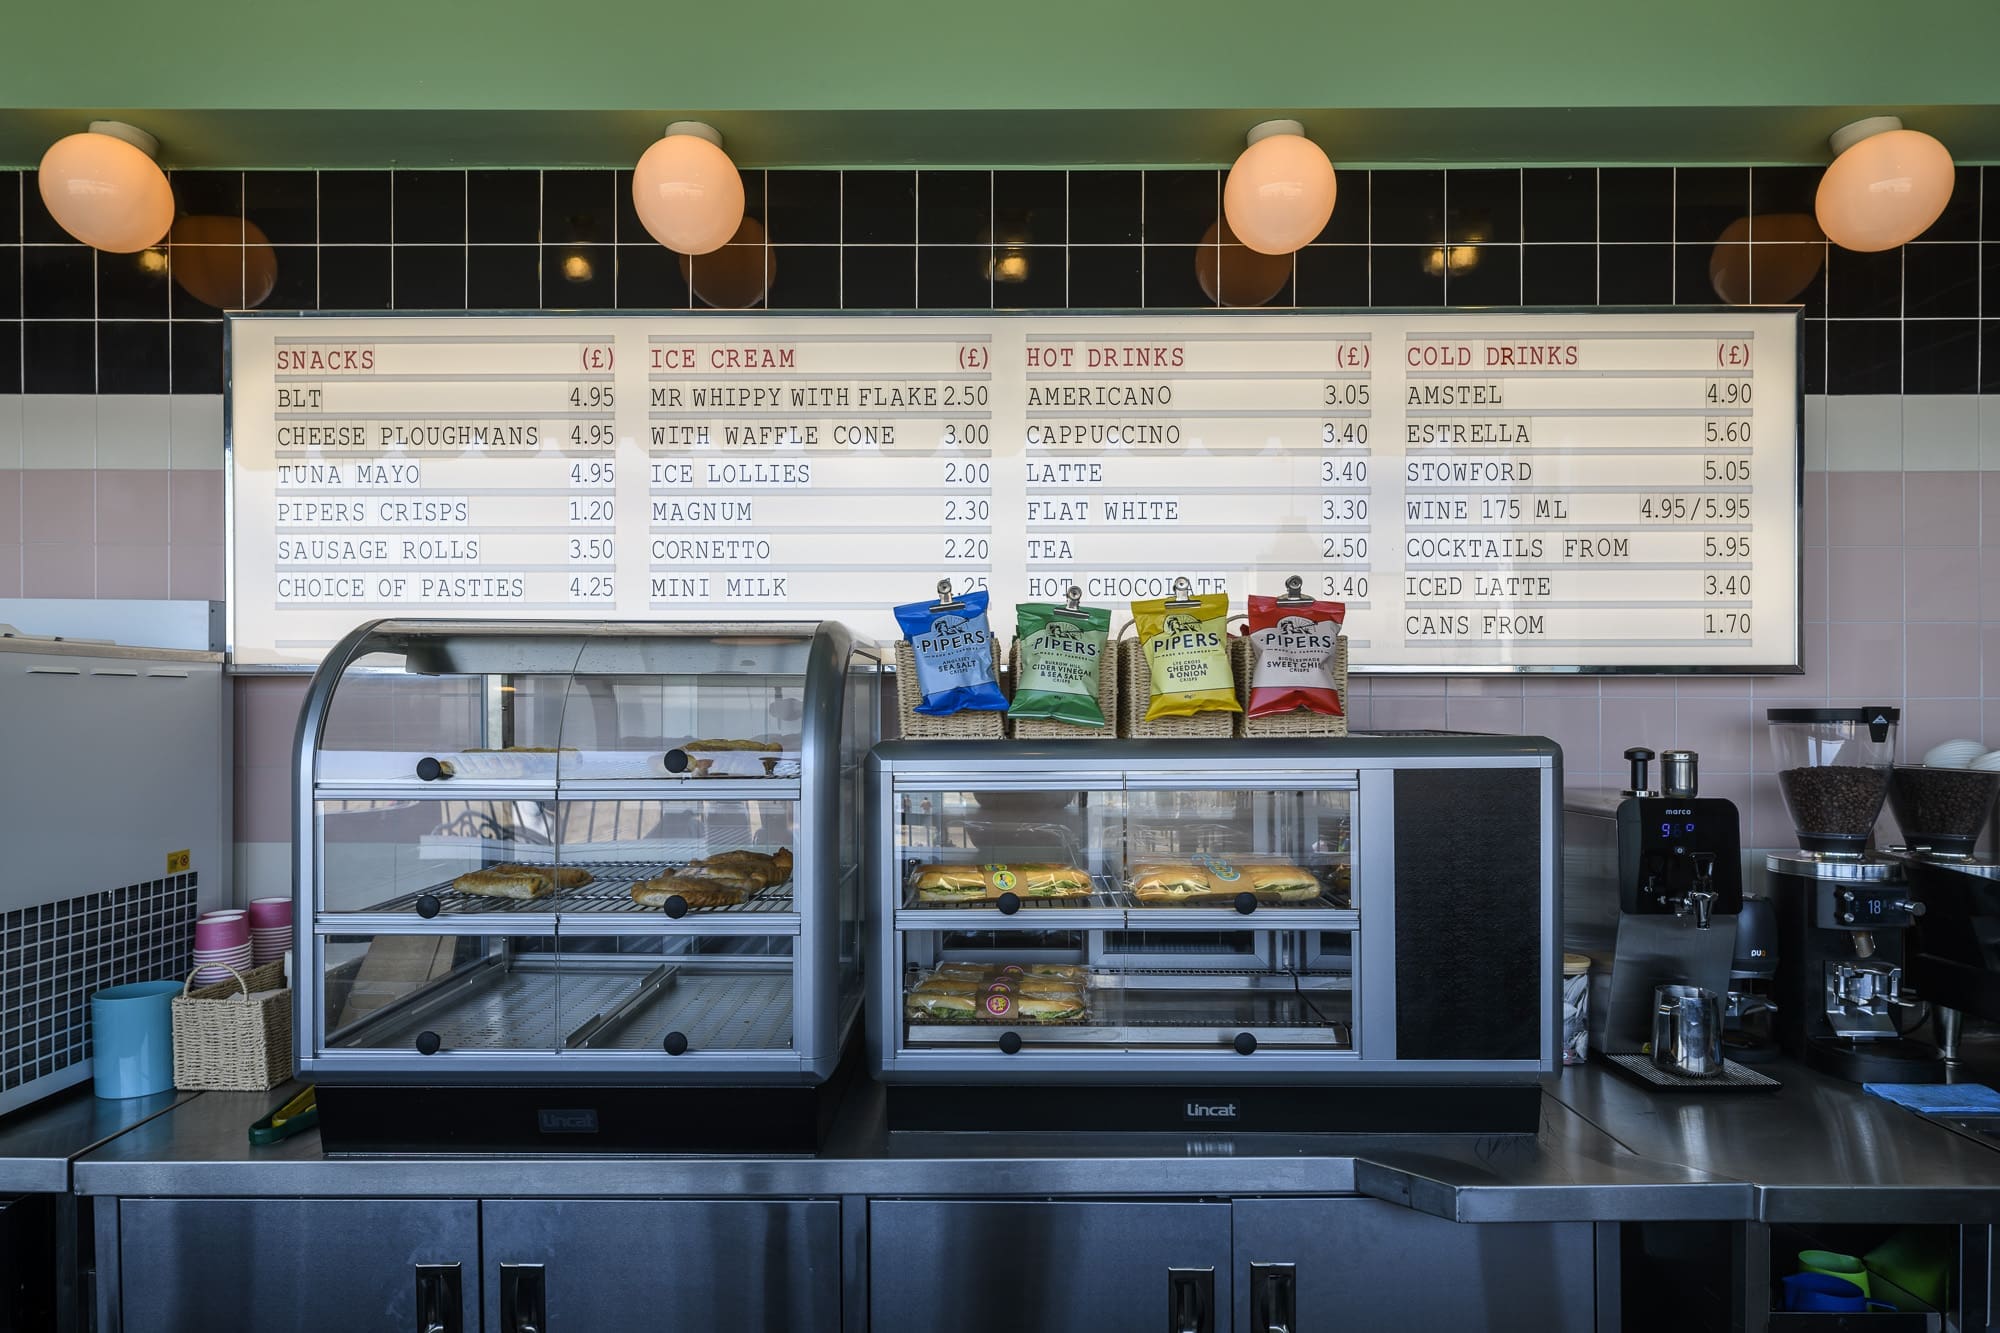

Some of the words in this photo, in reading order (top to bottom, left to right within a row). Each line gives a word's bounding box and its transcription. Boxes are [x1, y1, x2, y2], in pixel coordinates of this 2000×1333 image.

[278, 351, 373, 369] SNACKS
[583, 348, 613, 370] (£)
[652, 350, 694, 368] ICE
[712, 349, 794, 368] CREAM
[960, 347, 988, 369] (£)
[1027, 348, 1073, 367] HOT
[1088, 348, 1183, 367] DRINKS
[1338, 345, 1369, 368] (£)
[1408, 347, 1470, 366] COLD
[1487, 346, 1577, 365] DRINKS
[1719, 344, 1749, 366] (£)
[278, 390, 320, 407] BLT
[571, 387, 613, 406] 4.95
[652, 389, 682, 406] MR
[693, 388, 780, 406] WHIPPY
[791, 388, 848, 406] WITH
[859, 388, 936, 406] FLAKE
[944, 386, 987, 405] 2.50
[1029, 386, 1171, 405] AMERICANO
[1326, 385, 1369, 404] 3.05
[1408, 386, 1501, 404] AMSTEL
[1708, 384, 1751, 403] 4.90
[278, 427, 364, 445] CHEESE
[381, 426, 537, 445] PLOUGHMANS
[571, 425, 613, 444] 4.95
[652, 426, 708, 444] WITH
[725, 426, 817, 444] WAFFLE
[834, 426, 894, 444] CONE
[946, 424, 988, 444] 3.00
[1027, 425, 1179, 444] CAPPUCCINO
[1325, 423, 1367, 444] 3.40
[1408, 424, 1529, 443] ESTRELLA
[1705, 422, 1750, 441] 5.60
[279, 464, 341, 483] TUNA
[358, 465, 418, 483] MAYO
[572, 463, 613, 482] 4.95
[652, 465, 692, 483] ICE
[708, 465, 809, 483] LOLLIES
[946, 463, 989, 483] 2.00
[1027, 464, 1101, 482] LATTE
[1323, 462, 1366, 481] 3.40
[1408, 463, 1531, 481] STOWFORD
[1704, 461, 1749, 480] 5.05
[279, 503, 363, 521] PIPERS
[381, 503, 469, 521] CRISPS
[571, 501, 613, 520] 1.20
[653, 503, 751, 520] MAGNUM
[946, 501, 988, 520] 2.30
[1028, 502, 1088, 520] FLAT
[1105, 502, 1177, 520] WHITE
[1324, 500, 1367, 519] 3.30
[1407, 501, 1467, 519] WINE
[1483, 500, 1520, 519] 175
[1537, 500, 1566, 518] ML
[1642, 498, 1749, 520] 4.95/5.95
[279, 541, 387, 559] SAUSAGE
[403, 541, 477, 559] ROLLS
[571, 539, 612, 558] 3.50
[653, 541, 769, 559] CORNETTO
[945, 539, 988, 559] 2.20
[1028, 541, 1072, 558] TEA
[1324, 538, 1366, 558] 2.50
[1407, 538, 1542, 557] COCKTAILS
[1565, 538, 1628, 557] FROM
[1706, 537, 1749, 556] 5.95
[279, 579, 363, 597] CHOICE
[379, 579, 405, 597] OF
[423, 579, 522, 597] PASTIES
[571, 577, 613, 596] 4.25
[652, 579, 708, 596] MINI
[727, 579, 786, 596] MILK
[1029, 578, 1073, 597] HOT
[1324, 577, 1367, 597] 3.40
[1407, 577, 1462, 596] ICED
[1476, 578, 1550, 595] LATTE
[1706, 575, 1750, 595] 3.40
[1407, 616, 1468, 634] CANS
[1484, 616, 1543, 634] FROM
[1706, 614, 1750, 633] 1.70
[921, 630, 986, 653] PIPERS
[1034, 636, 1096, 656] PIPERS
[1154, 632, 1219, 653] PIPERS
[1266, 633, 1331, 648] PIPERS
[938, 663, 955, 672] SEA
[957, 660, 976, 669] SALT
[1167, 663, 1208, 673] CHEDDAR
[1176, 669, 1207, 679] ONION
[1867, 899, 1881, 915] 18
